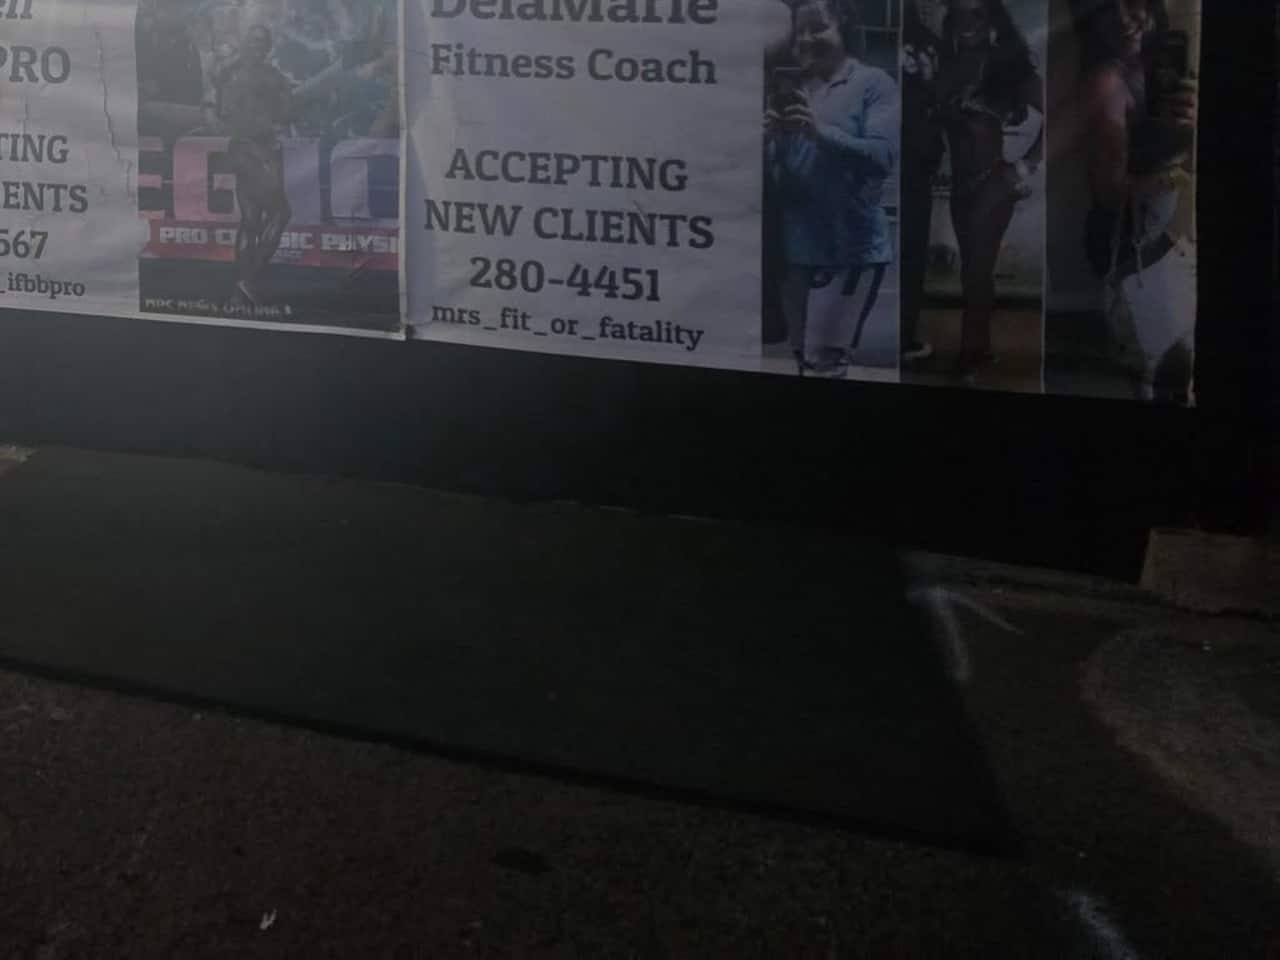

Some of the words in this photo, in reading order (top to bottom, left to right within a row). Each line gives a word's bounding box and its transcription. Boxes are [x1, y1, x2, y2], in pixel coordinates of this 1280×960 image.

[431, 43, 575, 79] Fitness
[587, 48, 718, 84] Coach
[445, 148, 689, 191] ACCEPTING
[424, 199, 523, 237] NEW
[533, 207, 715, 250] CLIENTS
[469, 257, 661, 302] 280-4451
[431, 304, 705, 351] mrs_fit_or_fatality
